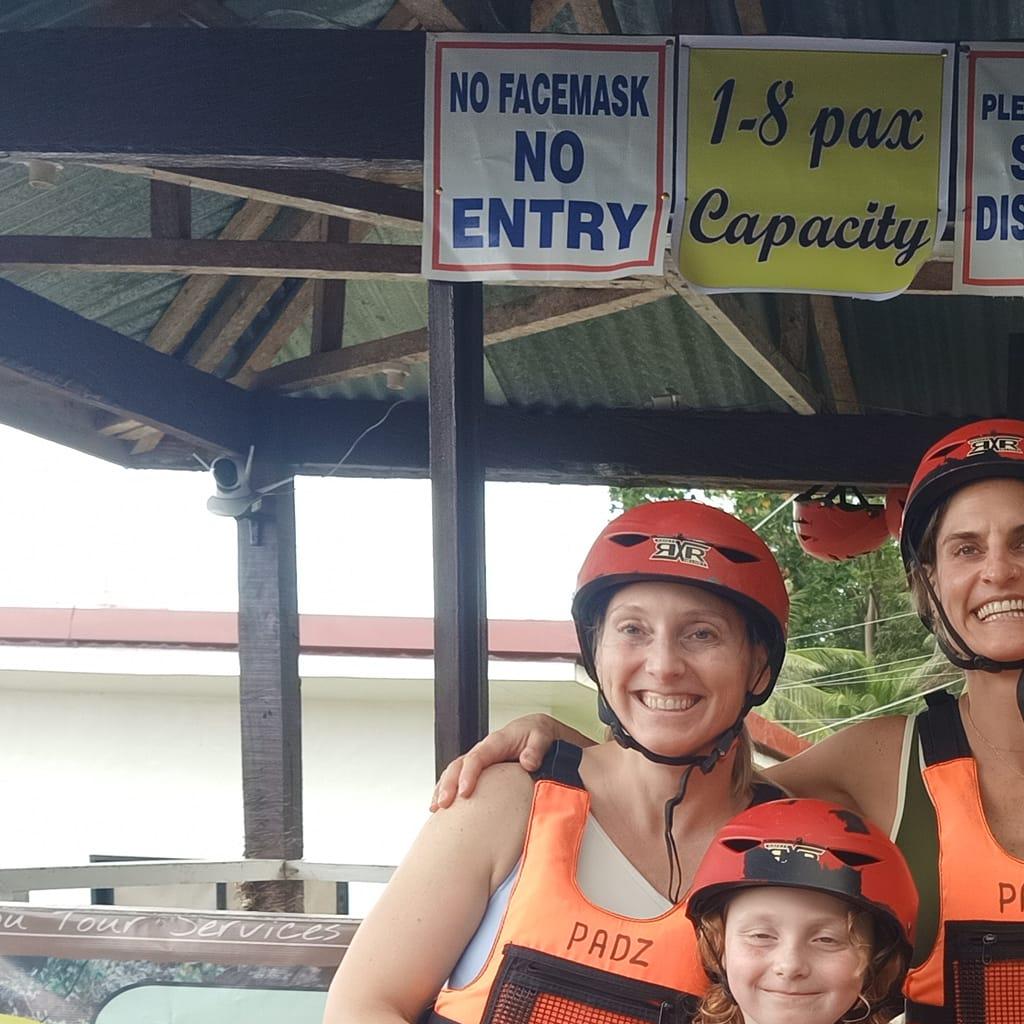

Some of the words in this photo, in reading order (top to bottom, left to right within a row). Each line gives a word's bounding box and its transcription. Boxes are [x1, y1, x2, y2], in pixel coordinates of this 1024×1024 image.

[450, 72, 489, 113] NO
[499, 73, 650, 117] FACEMASK
[710, 78, 794, 146] 1-8
[809, 106, 925, 169] pax
[514, 130, 584, 184] NO
[452, 197, 649, 251] ENTRY
[689, 188, 931, 267] Capacity
[53, 910, 149, 934] Tour
[169, 912, 342, 941] Services
[566, 921, 653, 968] PADZ
